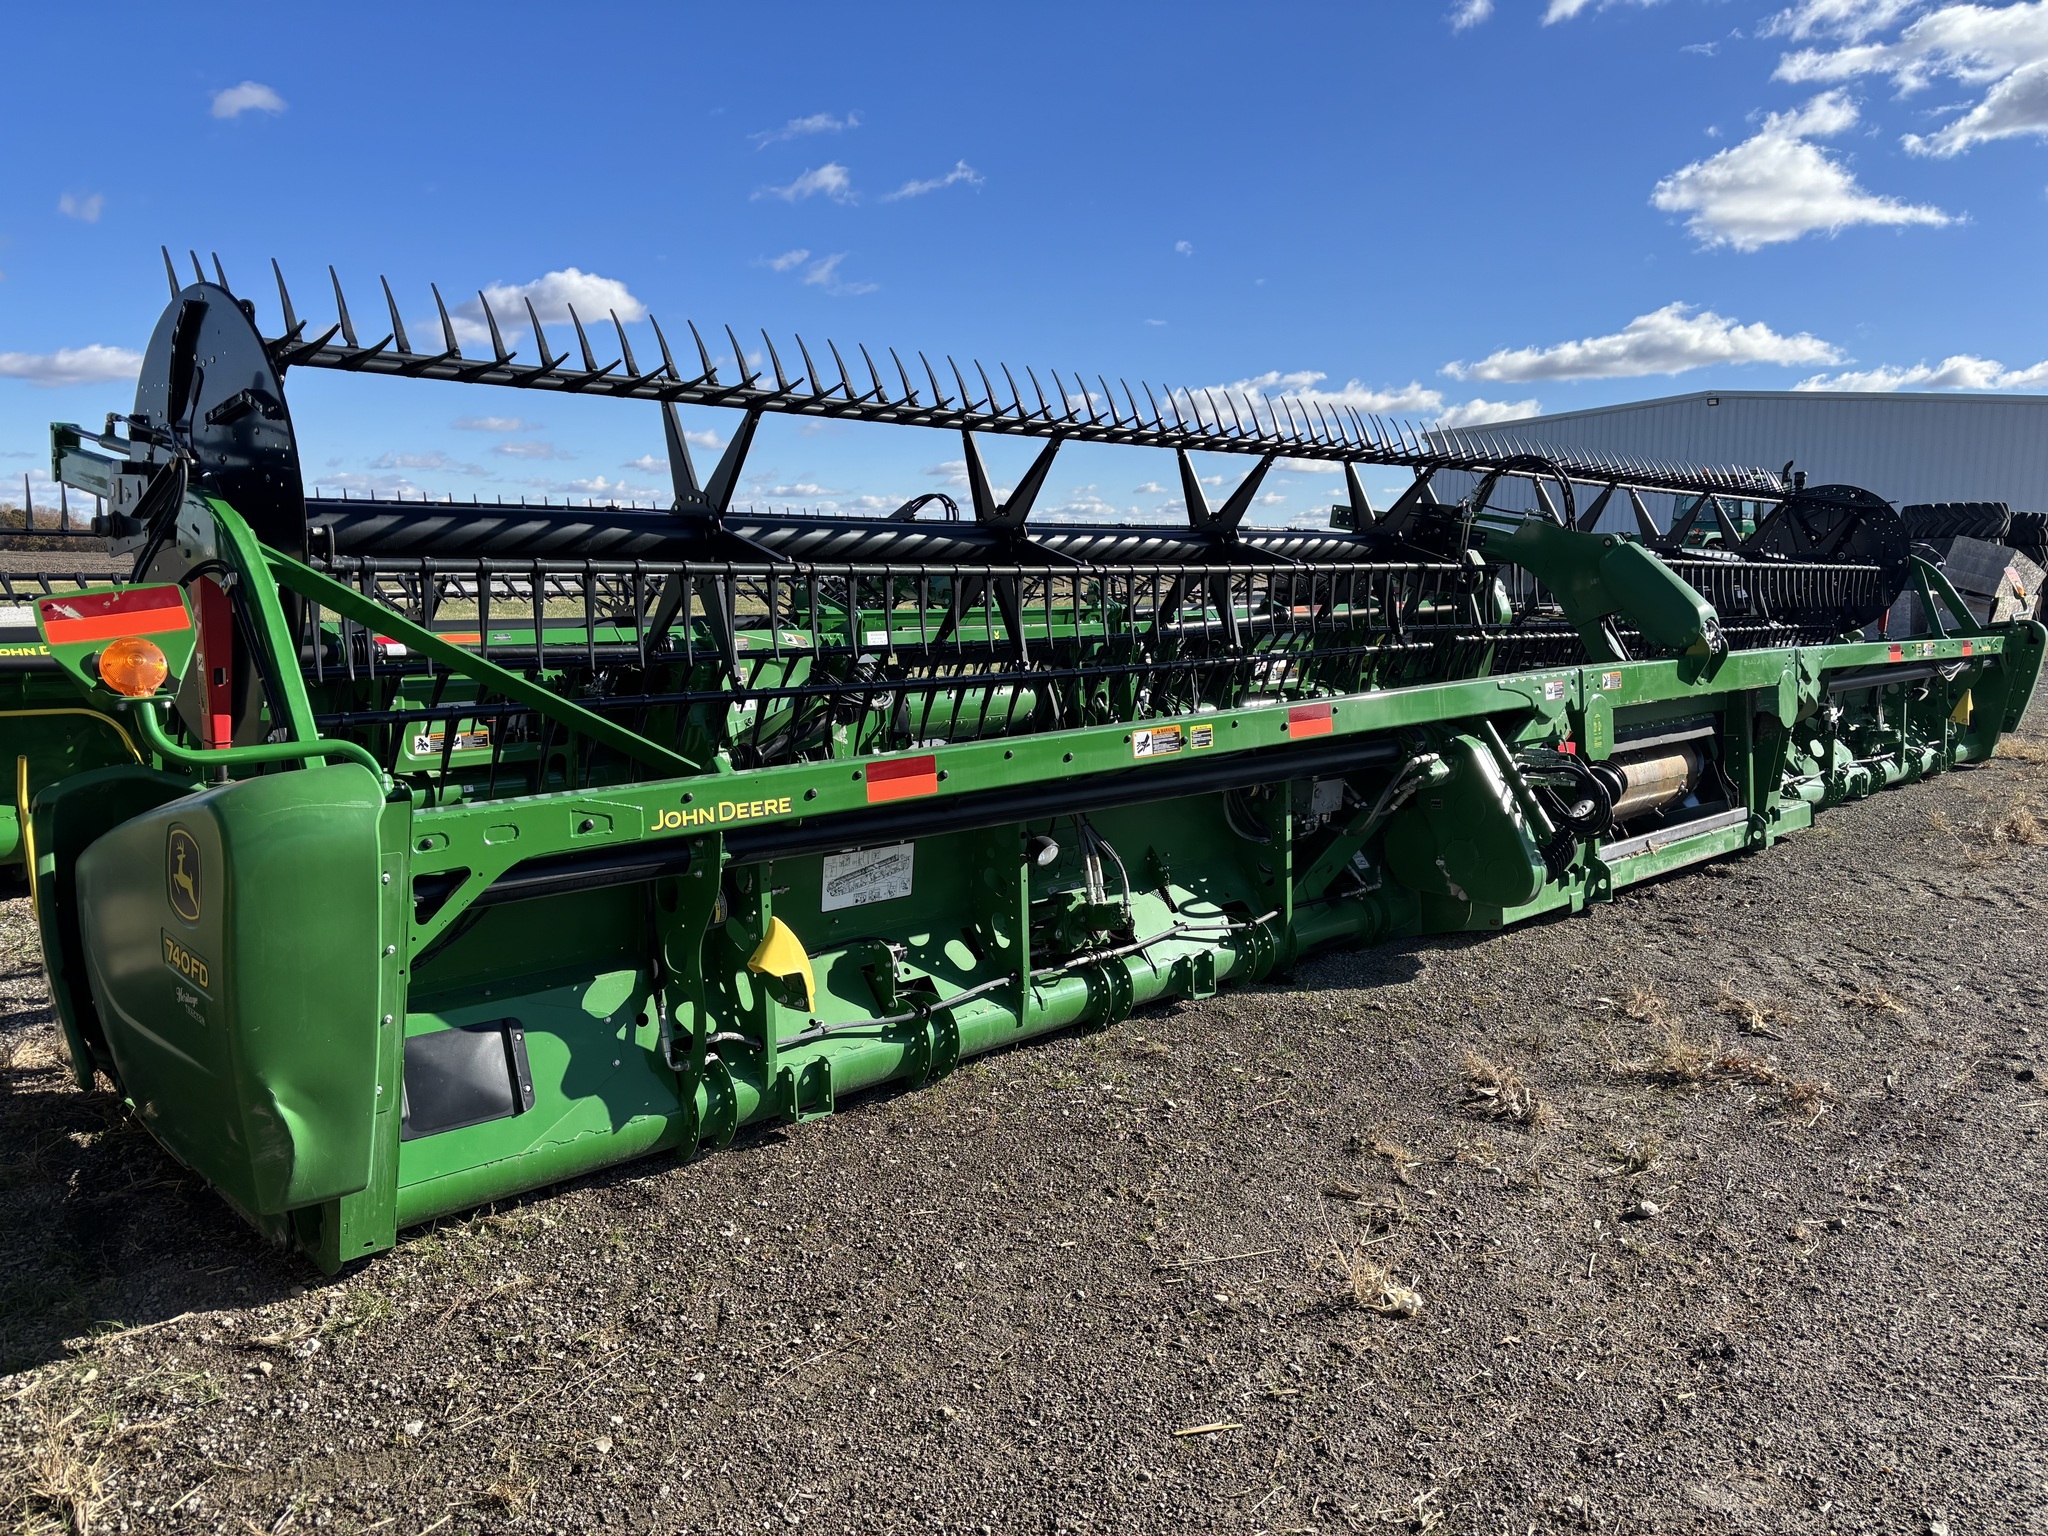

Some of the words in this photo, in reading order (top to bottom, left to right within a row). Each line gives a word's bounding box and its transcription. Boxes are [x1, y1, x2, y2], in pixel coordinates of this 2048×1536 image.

[0, 648, 36, 656] OHN
[651, 807, 714, 830] JOHN
[718, 797, 791, 821] DEERE
[165, 938, 209, 988] 740FD
